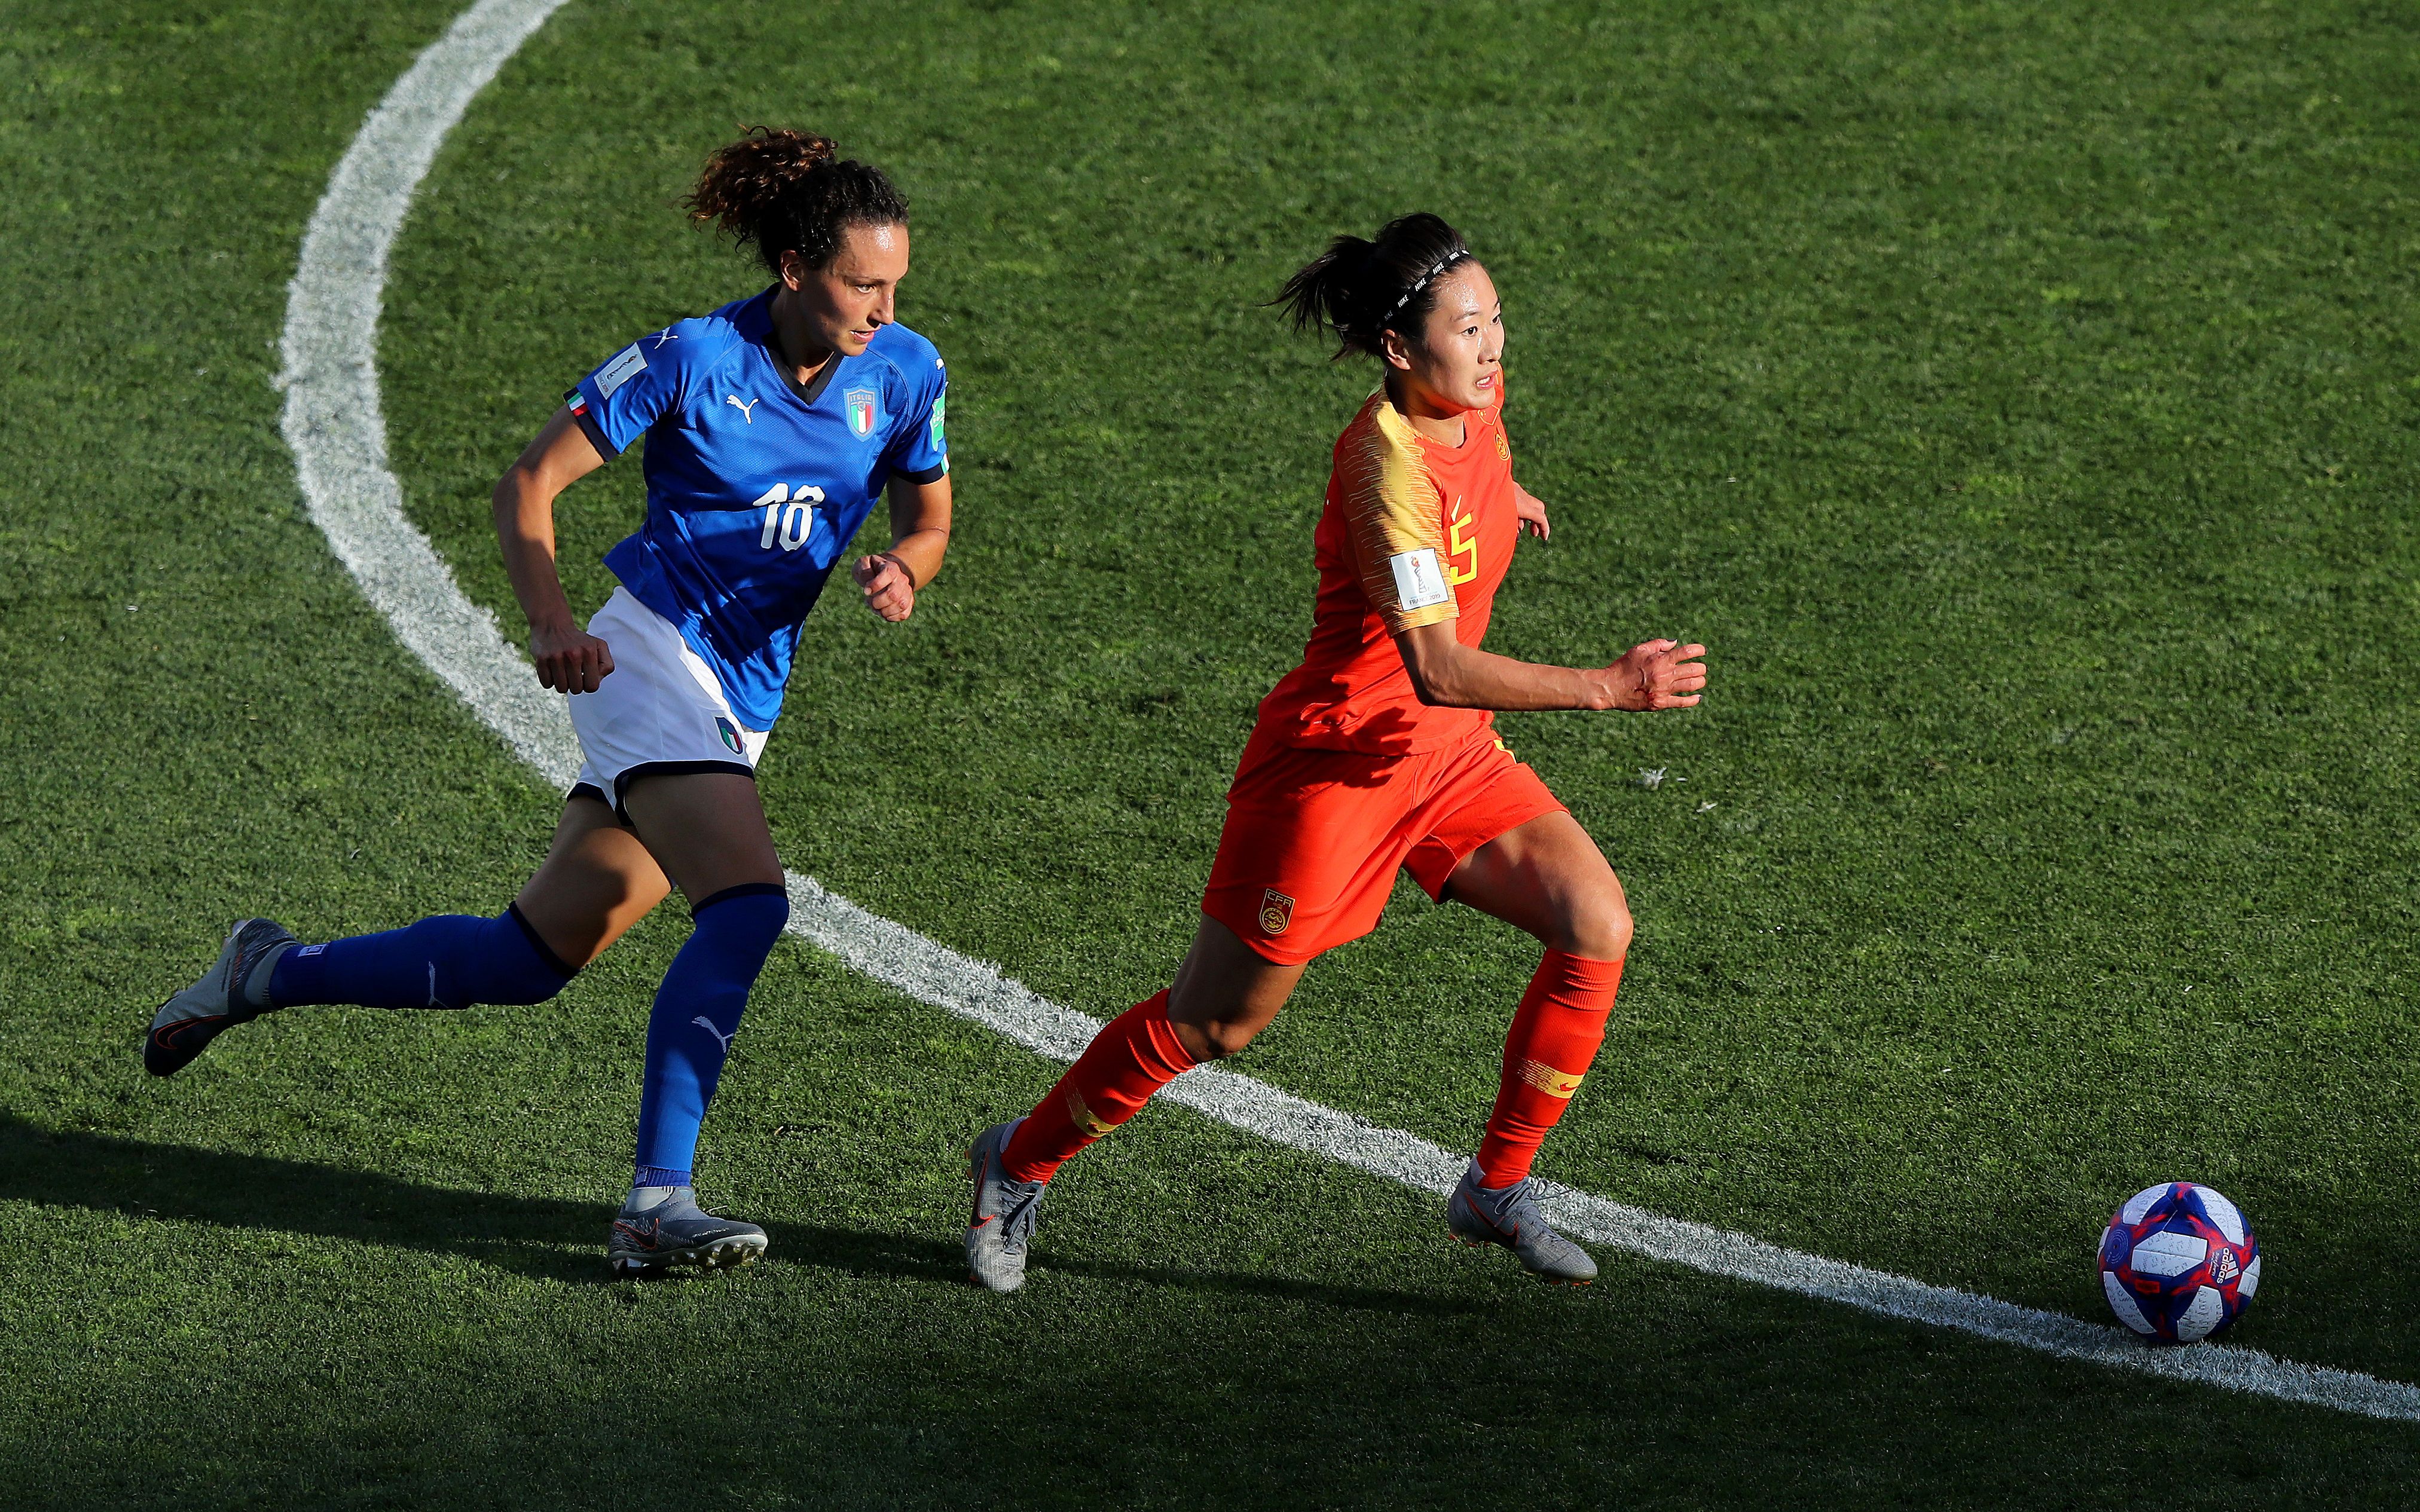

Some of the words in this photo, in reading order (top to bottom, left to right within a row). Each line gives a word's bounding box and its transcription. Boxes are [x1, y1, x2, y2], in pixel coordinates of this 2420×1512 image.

[1397, 294, 1409, 308] NIKE
[1414, 277, 1427, 292] NIKE
[1432, 262, 1444, 275] NIKE
[1449, 512, 1477, 586] 5
[1267, 892, 1292, 907] CFA
[2216, 1247, 2230, 1284] adidas
